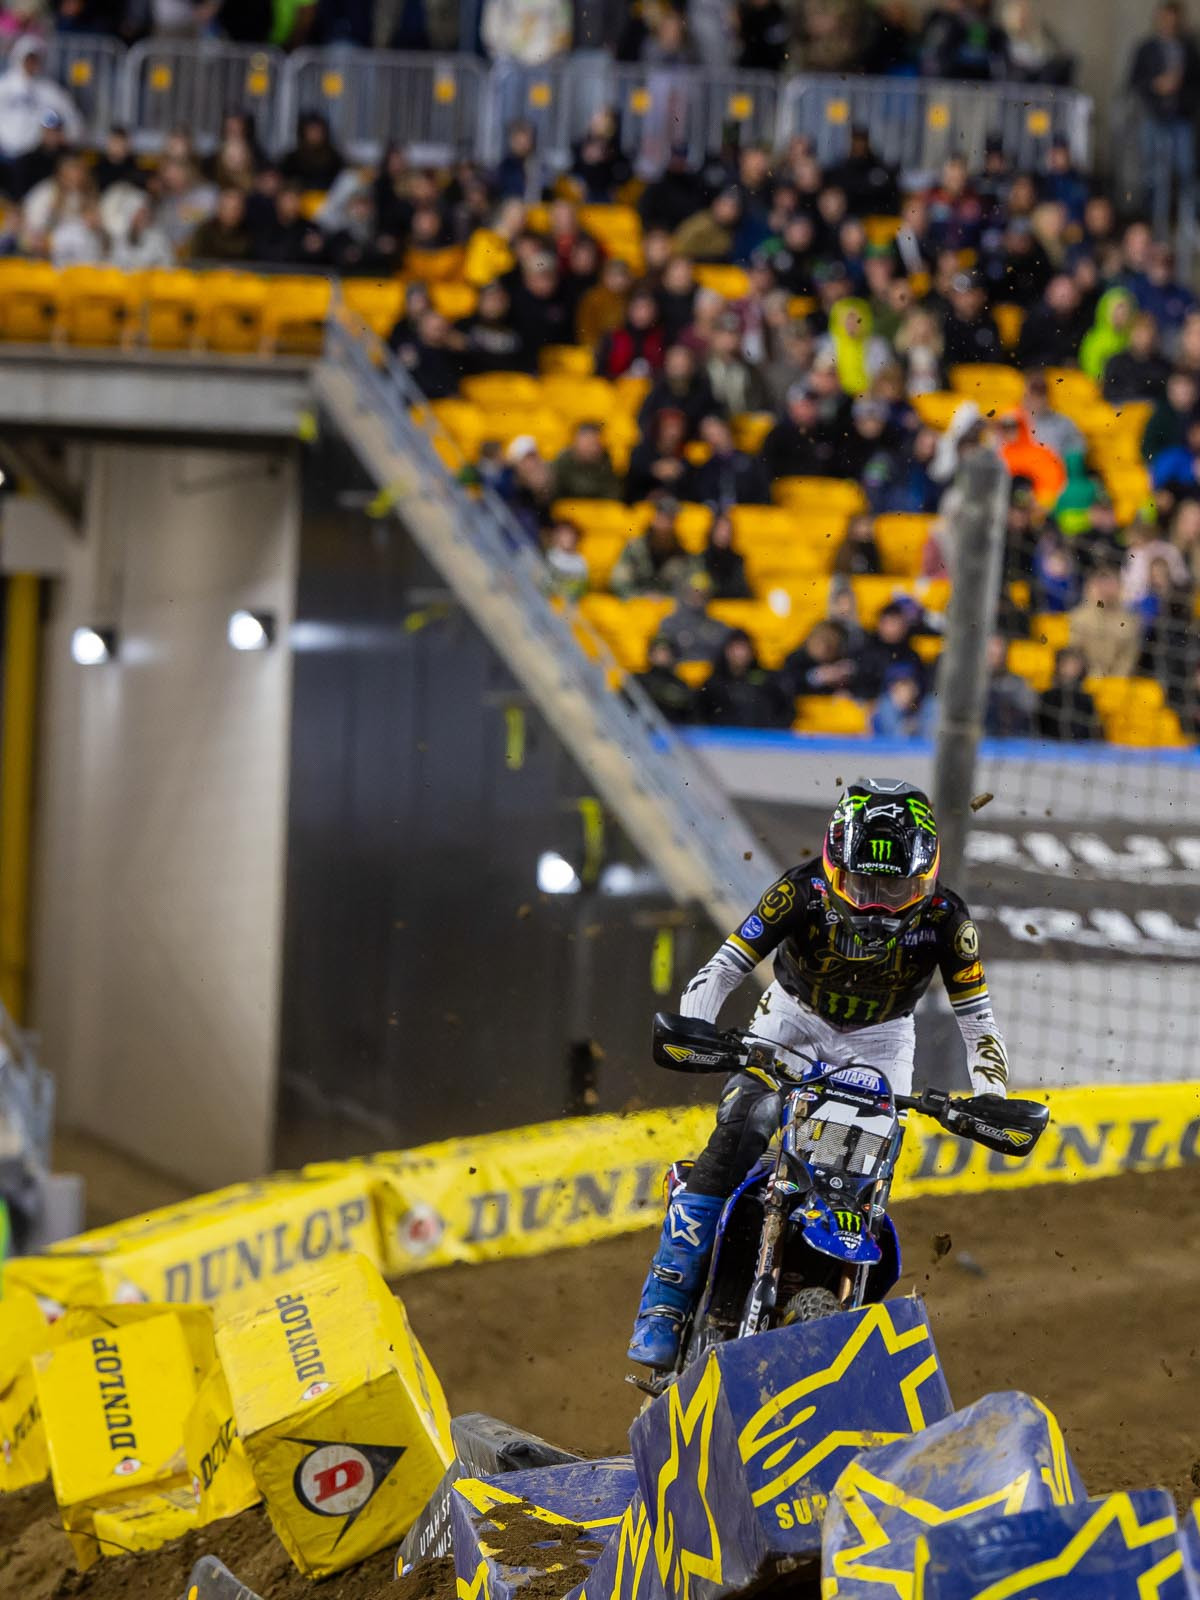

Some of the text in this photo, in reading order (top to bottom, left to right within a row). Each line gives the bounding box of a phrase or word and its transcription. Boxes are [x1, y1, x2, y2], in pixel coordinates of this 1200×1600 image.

[856, 862, 902, 874] MONSTER
[825, 1088, 875, 1106] SUPERCROSS
[975, 1122, 1010, 1141] CYCRA
[463, 1162, 665, 1243] DUNL
[164, 1198, 367, 1303] DUNLOP
[274, 1293, 326, 1383] DUNLOP
[92, 1336, 137, 1451] DUNLOP
[313, 1459, 366, 1504] D
[775, 1493, 829, 1530] SUP
[420, 1513, 441, 1557] UTAH
